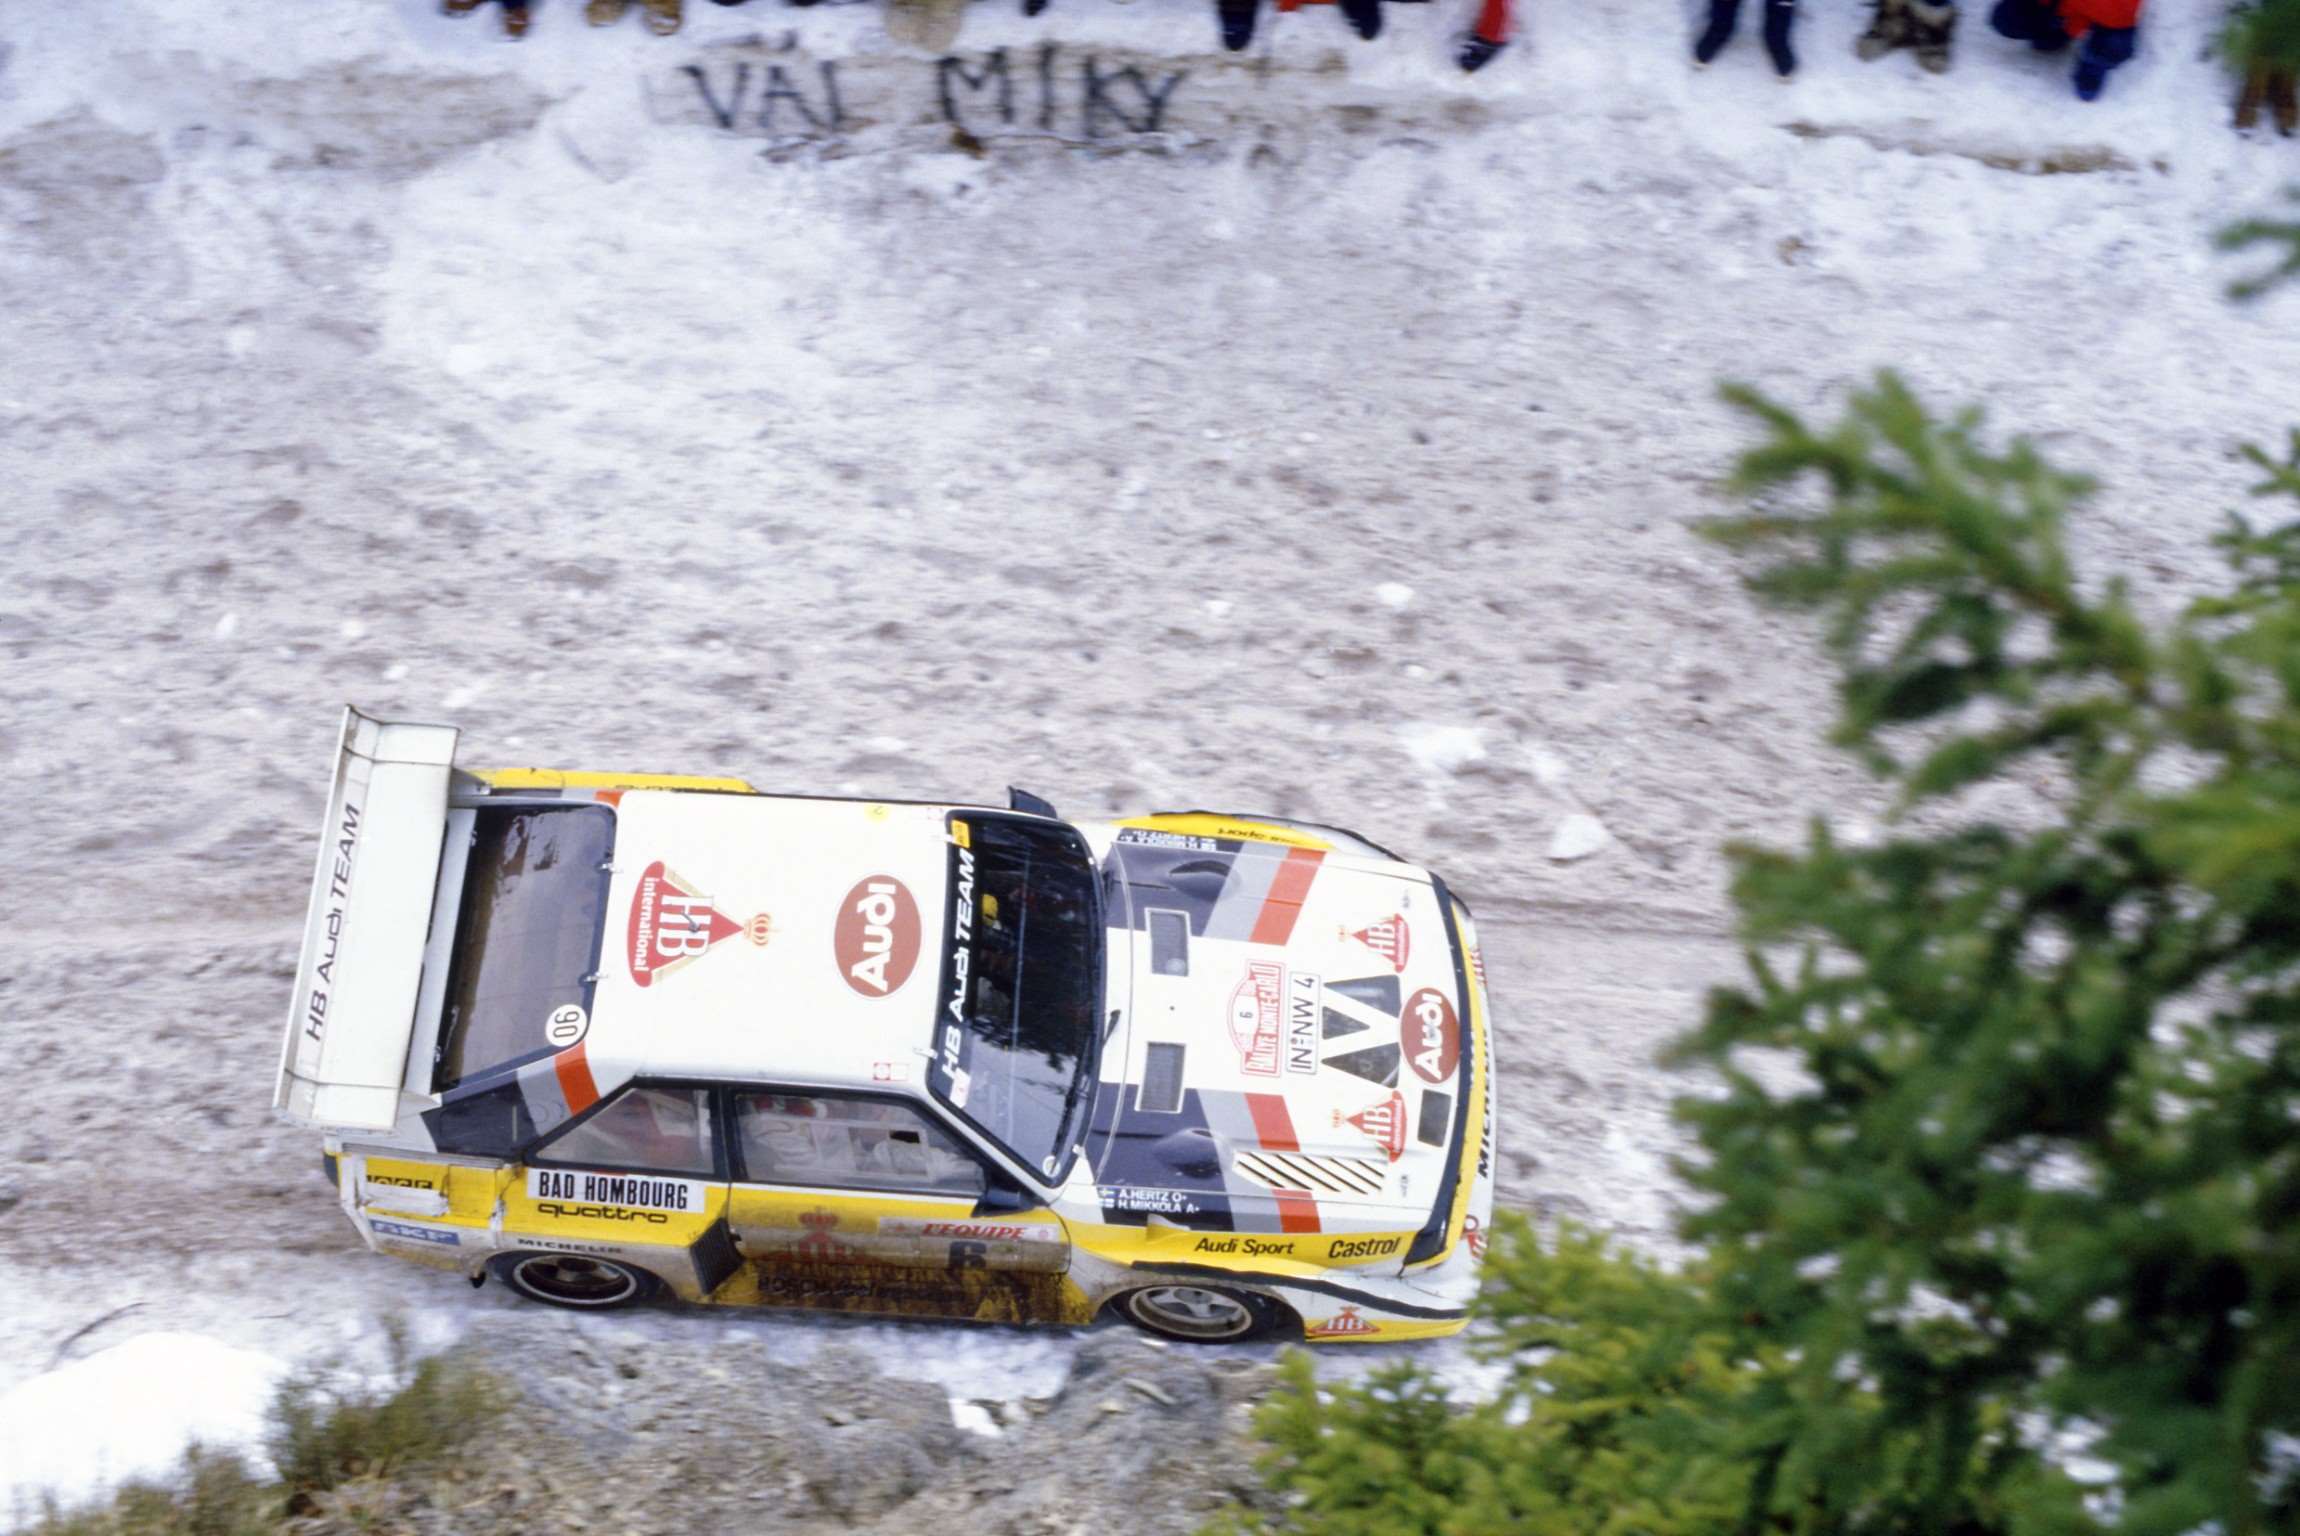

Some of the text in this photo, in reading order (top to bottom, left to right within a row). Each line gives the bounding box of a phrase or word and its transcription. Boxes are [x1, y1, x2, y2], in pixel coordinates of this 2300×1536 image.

[937, 42, 1189, 138] MIKY
[956, 847, 976, 942] TEAM
[306, 803, 361, 1042] HB Audi TEAM
[633, 877, 661, 972] international
[656, 894, 716, 958] HB
[851, 882, 898, 993] Audi
[1367, 923, 1395, 956] HB
[949, 947, 970, 1023] Audi
[1293, 977, 1315, 989] 4
[553, 1010, 580, 1038] 90
[1239, 1011, 1254, 1019] 6
[1414, 992, 1444, 1081] Audi
[942, 1024, 962, 1081] HB
[1362, 1104, 1392, 1143] HB
[537, 1202, 668, 1224] quattro
[538, 1171, 689, 1209] BAD HOMBOURG
[1195, 1237, 1295, 1256] Audi Sport
[1328, 1236, 1402, 1259] Castrol
